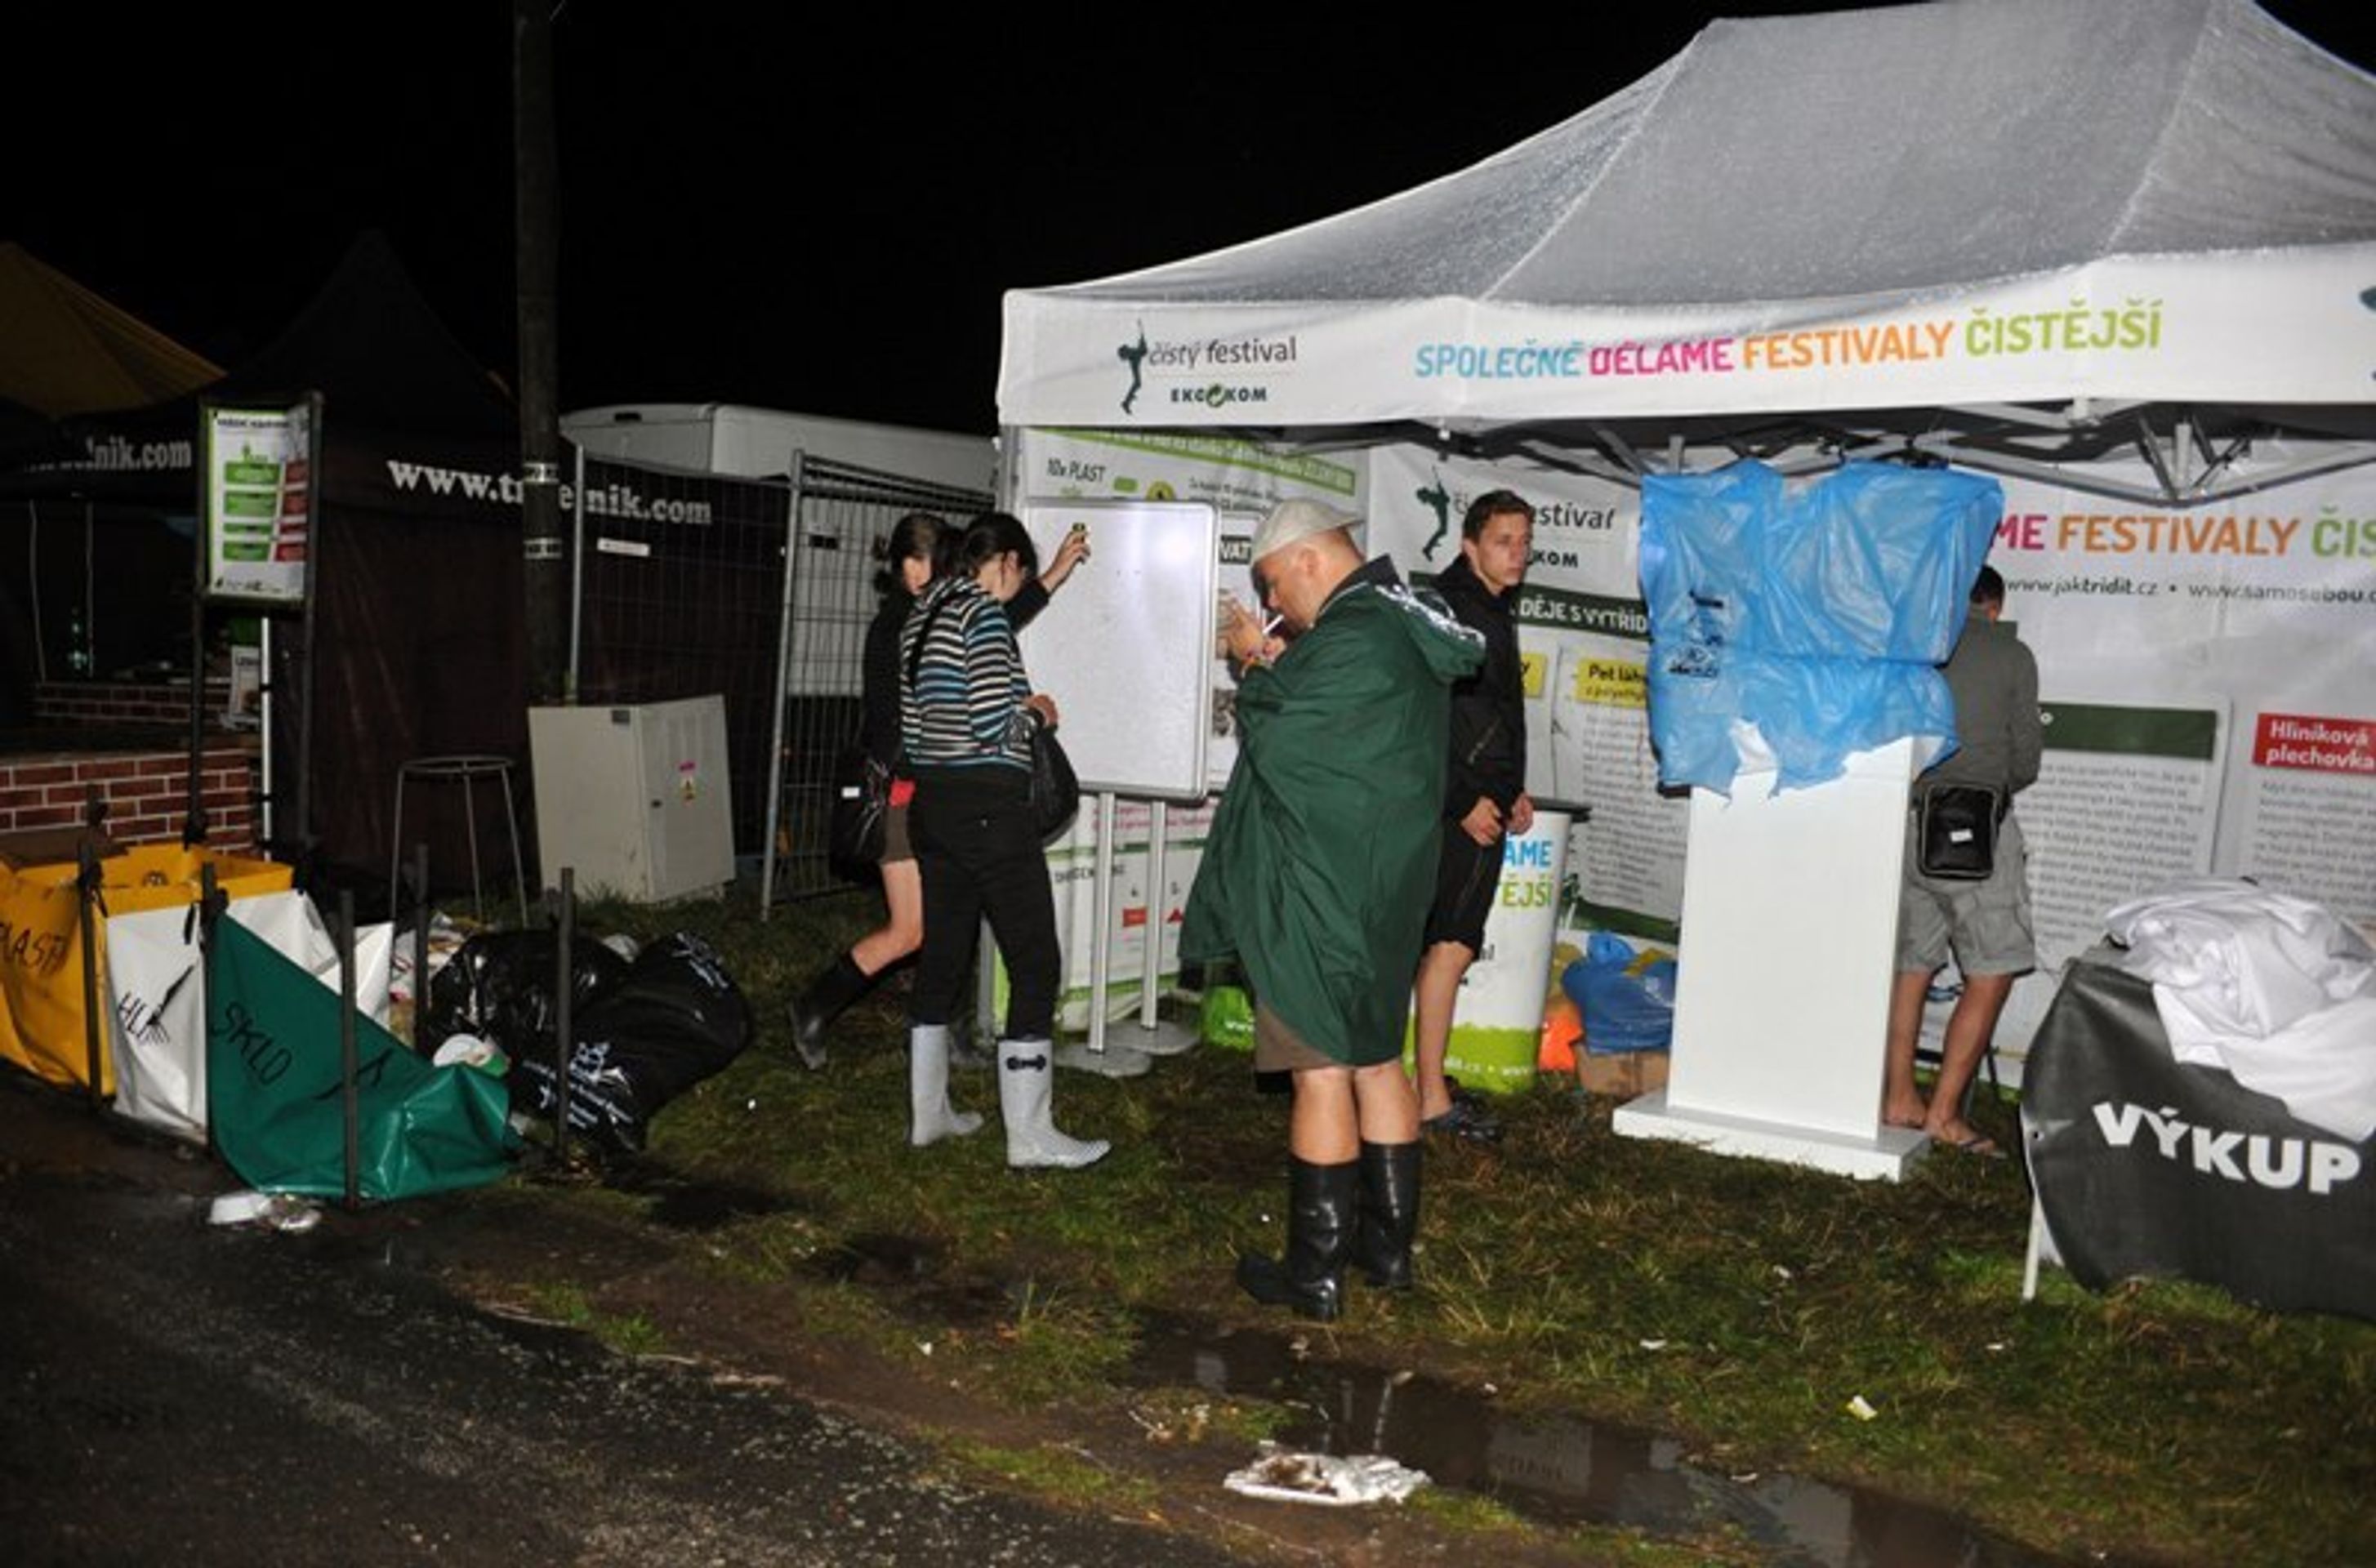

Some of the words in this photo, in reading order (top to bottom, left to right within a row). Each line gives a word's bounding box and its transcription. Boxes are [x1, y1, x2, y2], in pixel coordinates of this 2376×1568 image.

[1206, 336, 1297, 364] festival
[1743, 322, 1955, 370] FESTIVALY
[1965, 299, 2164, 357] ČISTĚJŠÍ
[1538, 501, 1616, 530] stival
[2058, 514, 2300, 557] FESTIVALY
[2312, 506, 2376, 558] ČIS
[2266, 743, 2375, 771] plechovka
[211, 1000, 293, 1087] SKLO
[2092, 1101, 2361, 1195] VÝKUP
